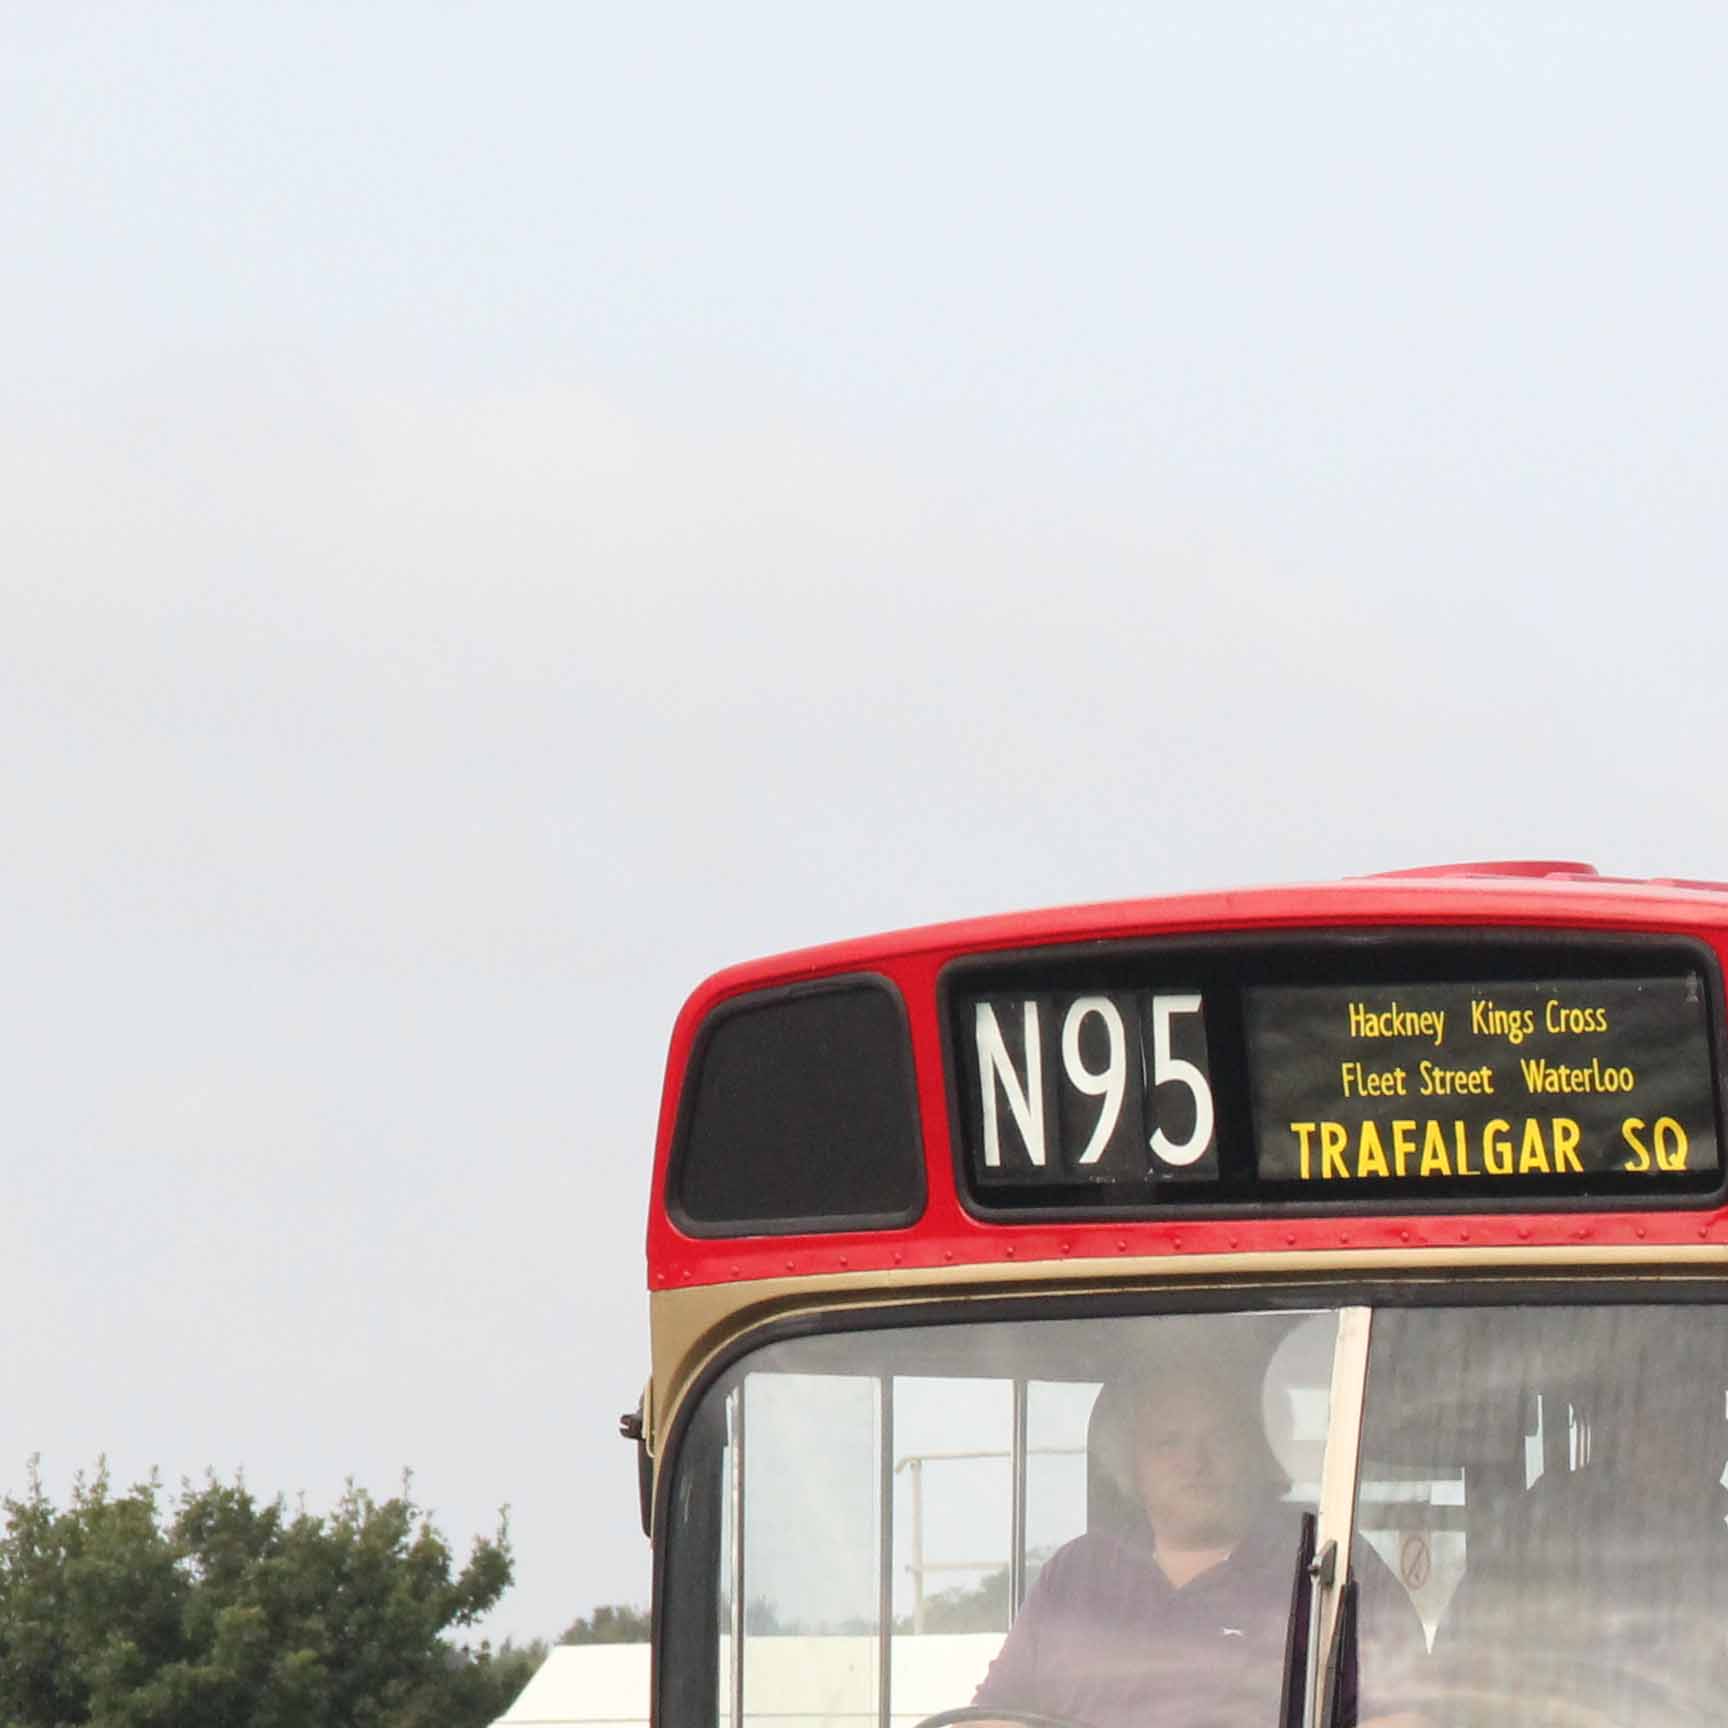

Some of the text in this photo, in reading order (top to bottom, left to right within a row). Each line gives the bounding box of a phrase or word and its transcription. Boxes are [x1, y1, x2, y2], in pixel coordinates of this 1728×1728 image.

[1348, 999, 1608, 1046] Hackney Kings Cross
[975, 994, 1214, 1167] N95
[1340, 1057, 1635, 1098] Fleet Street Waterloo
[1290, 1116, 1689, 1180] TRAFALGAR SQ
